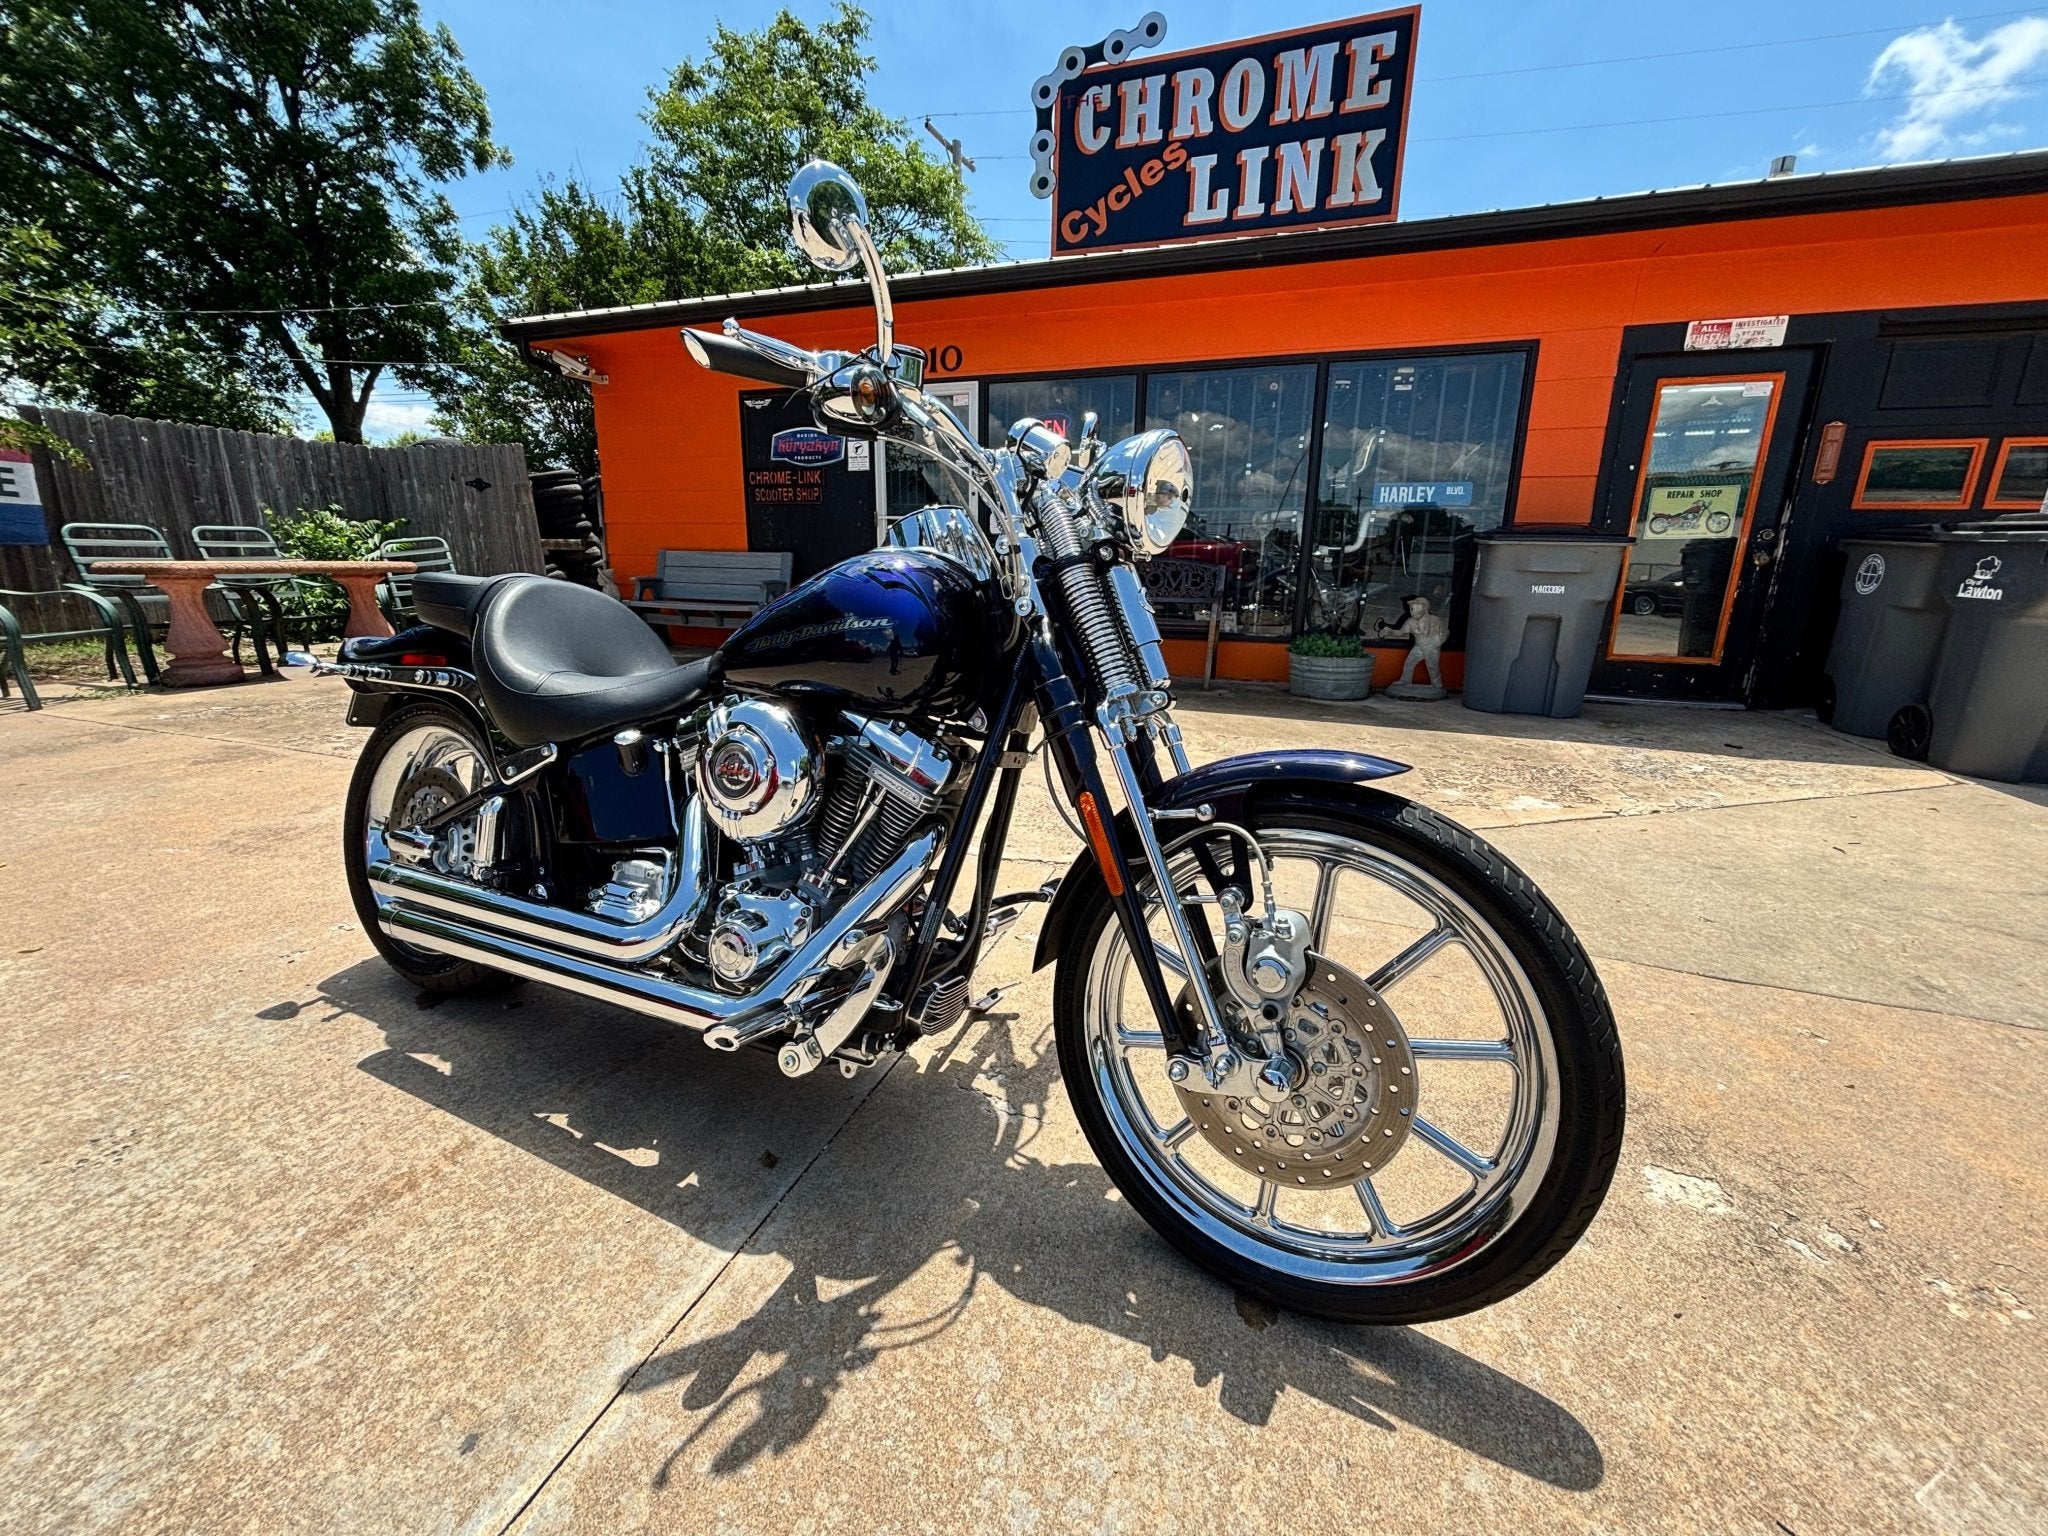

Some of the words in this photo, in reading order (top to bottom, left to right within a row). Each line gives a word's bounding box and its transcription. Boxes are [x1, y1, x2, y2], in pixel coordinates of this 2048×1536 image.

[1074, 30, 1398, 155] CHROME
[1183, 128, 1387, 226] LINK
[1060, 140, 1188, 244] Cycles
[1701, 324, 1719, 333] ALL
[1735, 318, 1786, 328] INVESTIGATED
[0, 466, 20, 498] E
[749, 470, 821, 485] CHROME-LINK
[755, 488, 794, 502] SCOOTER
[796, 487, 820, 501] SHOP
[1379, 486, 1436, 503] HARLEY
[1445, 486, 1465, 495] BLVD.
[1667, 490, 1694, 499] REPAIR
[1700, 489, 1723, 498] SHOP
[1956, 583, 2003, 600] Lawton
